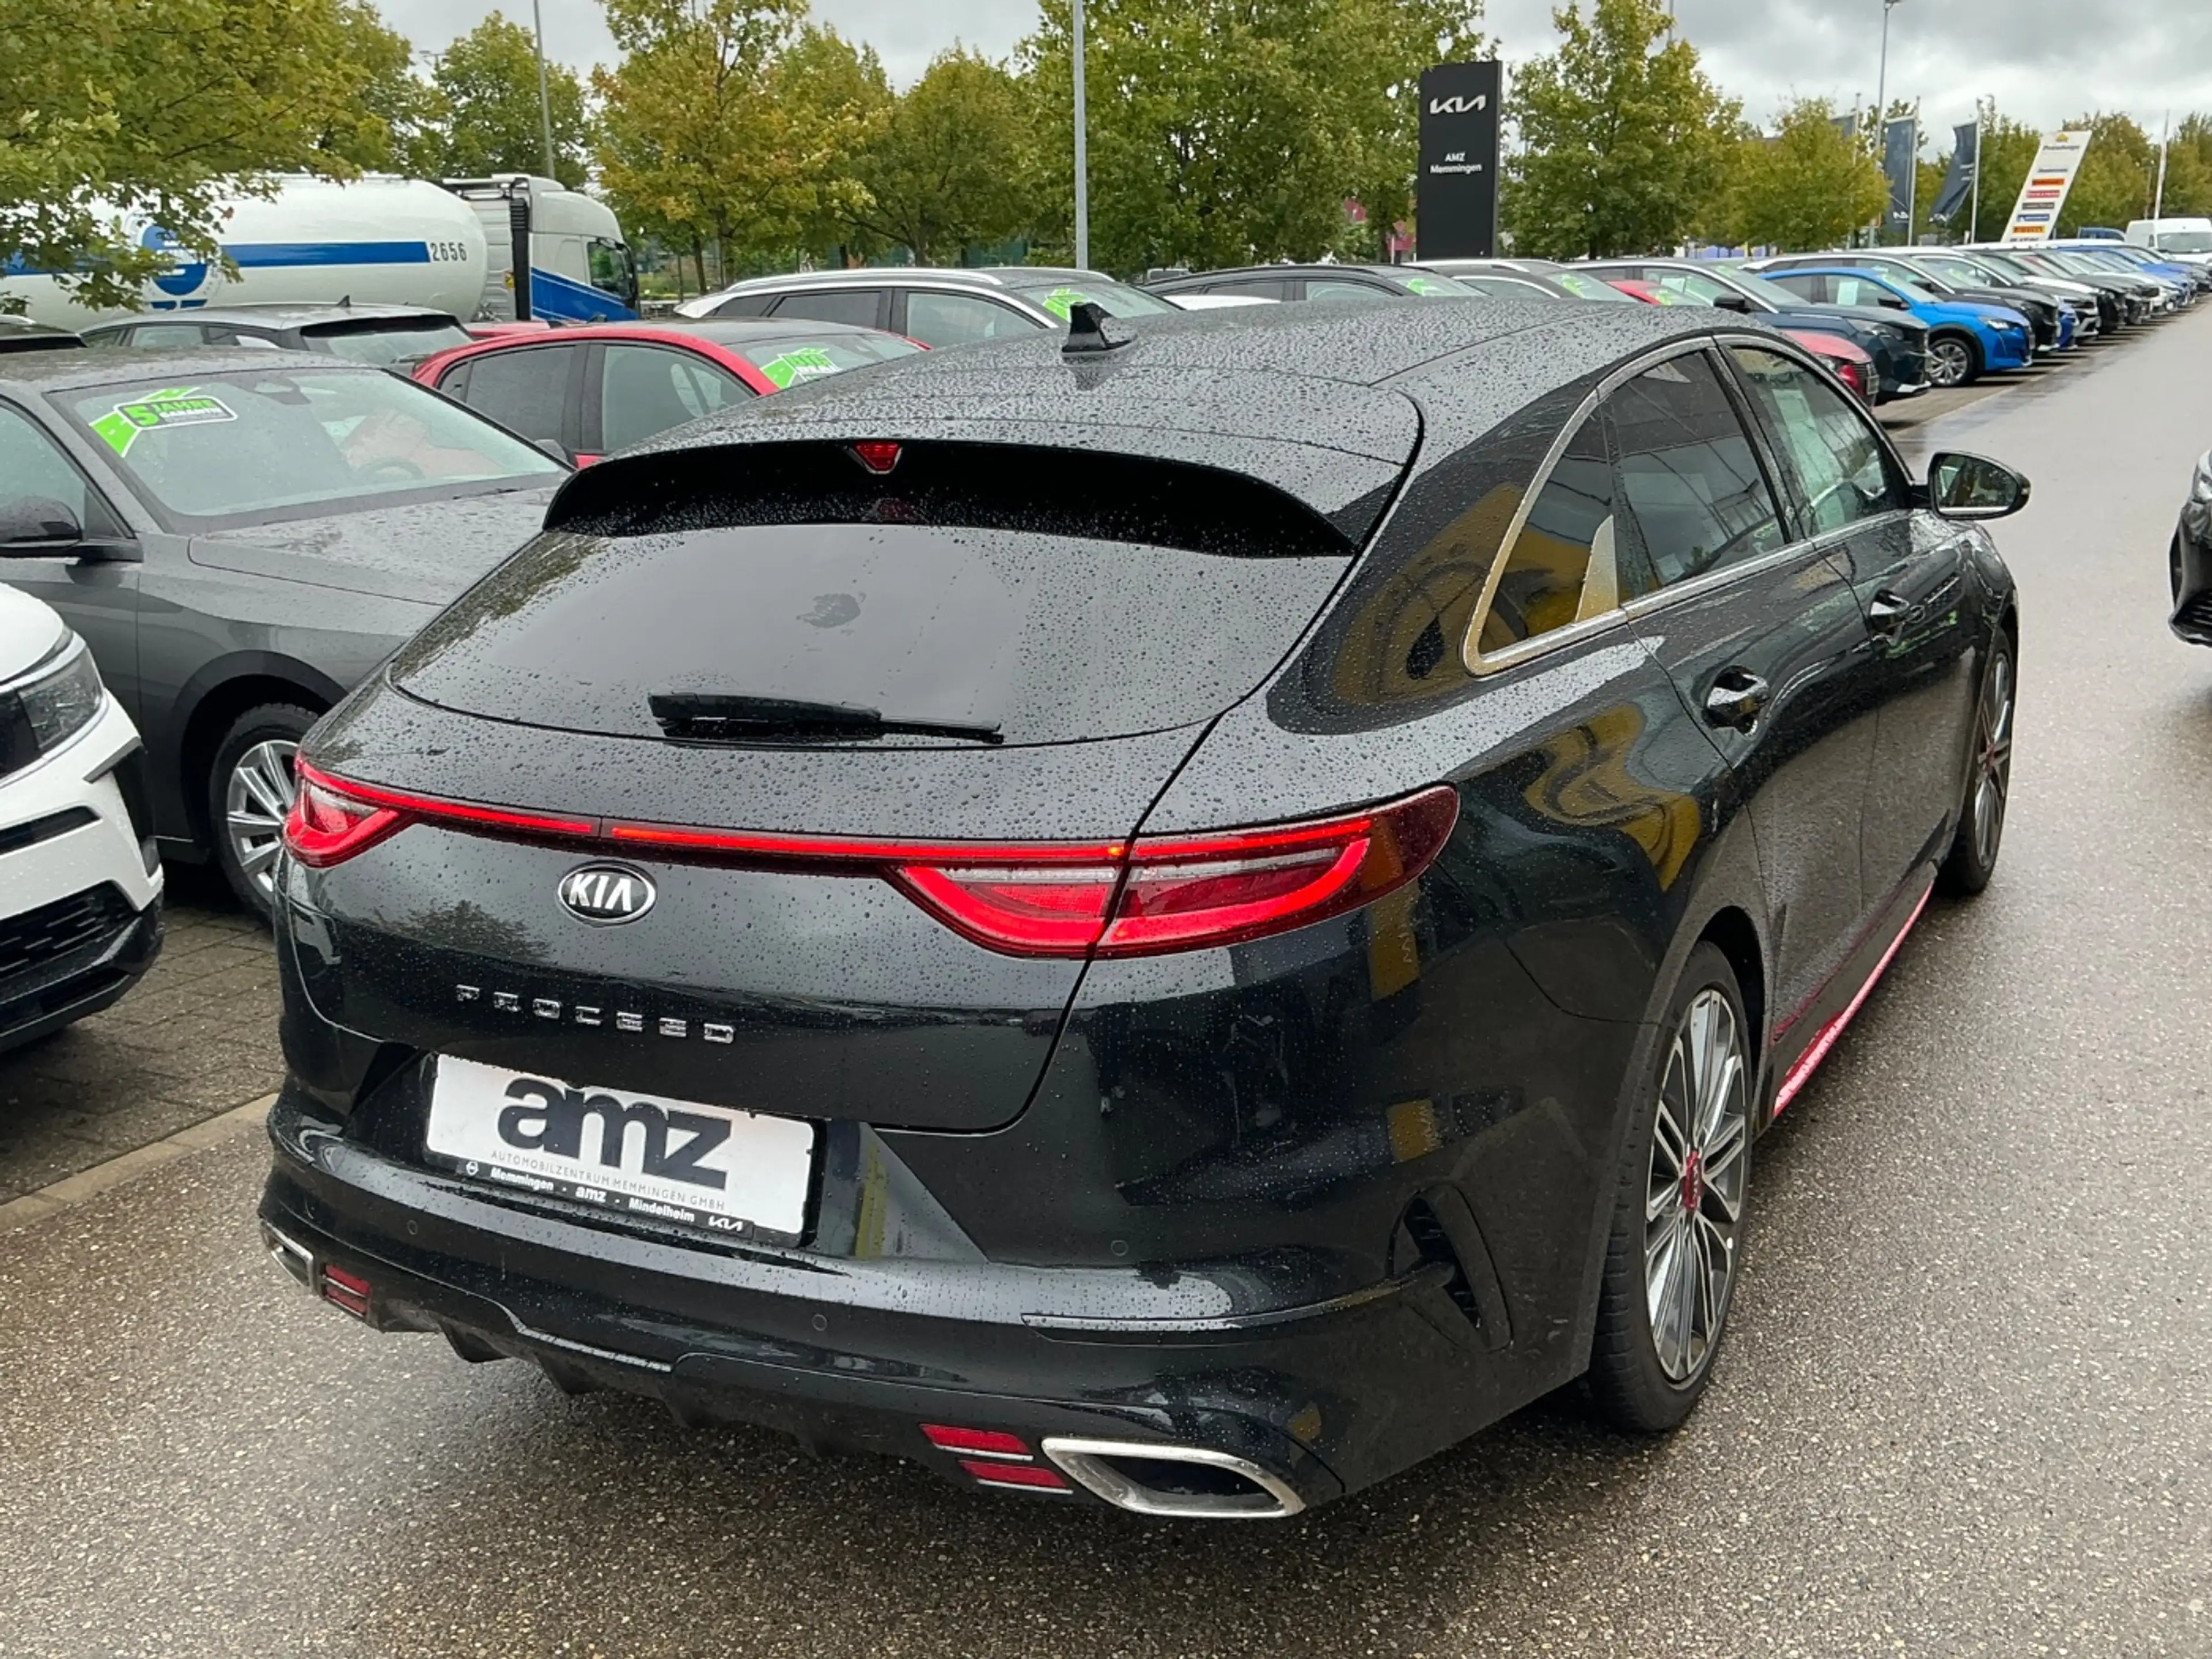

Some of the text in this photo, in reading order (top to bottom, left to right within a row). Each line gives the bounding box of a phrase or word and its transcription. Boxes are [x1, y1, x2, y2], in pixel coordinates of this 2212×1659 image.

[1430, 164, 1482, 175] Memmingen
[1444, 151, 1466, 162] AMZ
[430, 242, 467, 262] 2656
[123, 406, 160, 426] 5
[569, 873, 632, 912] KIA
[456, 983, 734, 1044] PROCEED
[497, 1078, 732, 1191] amz
[490, 1150, 725, 1211] AUTOMOBILZENTRUM MEMMINGEN GMBH
[490, 1166, 555, 1191] Memmingen
[575, 1185, 608, 1203] amz
[628, 1197, 695, 1223] Mindelheim
